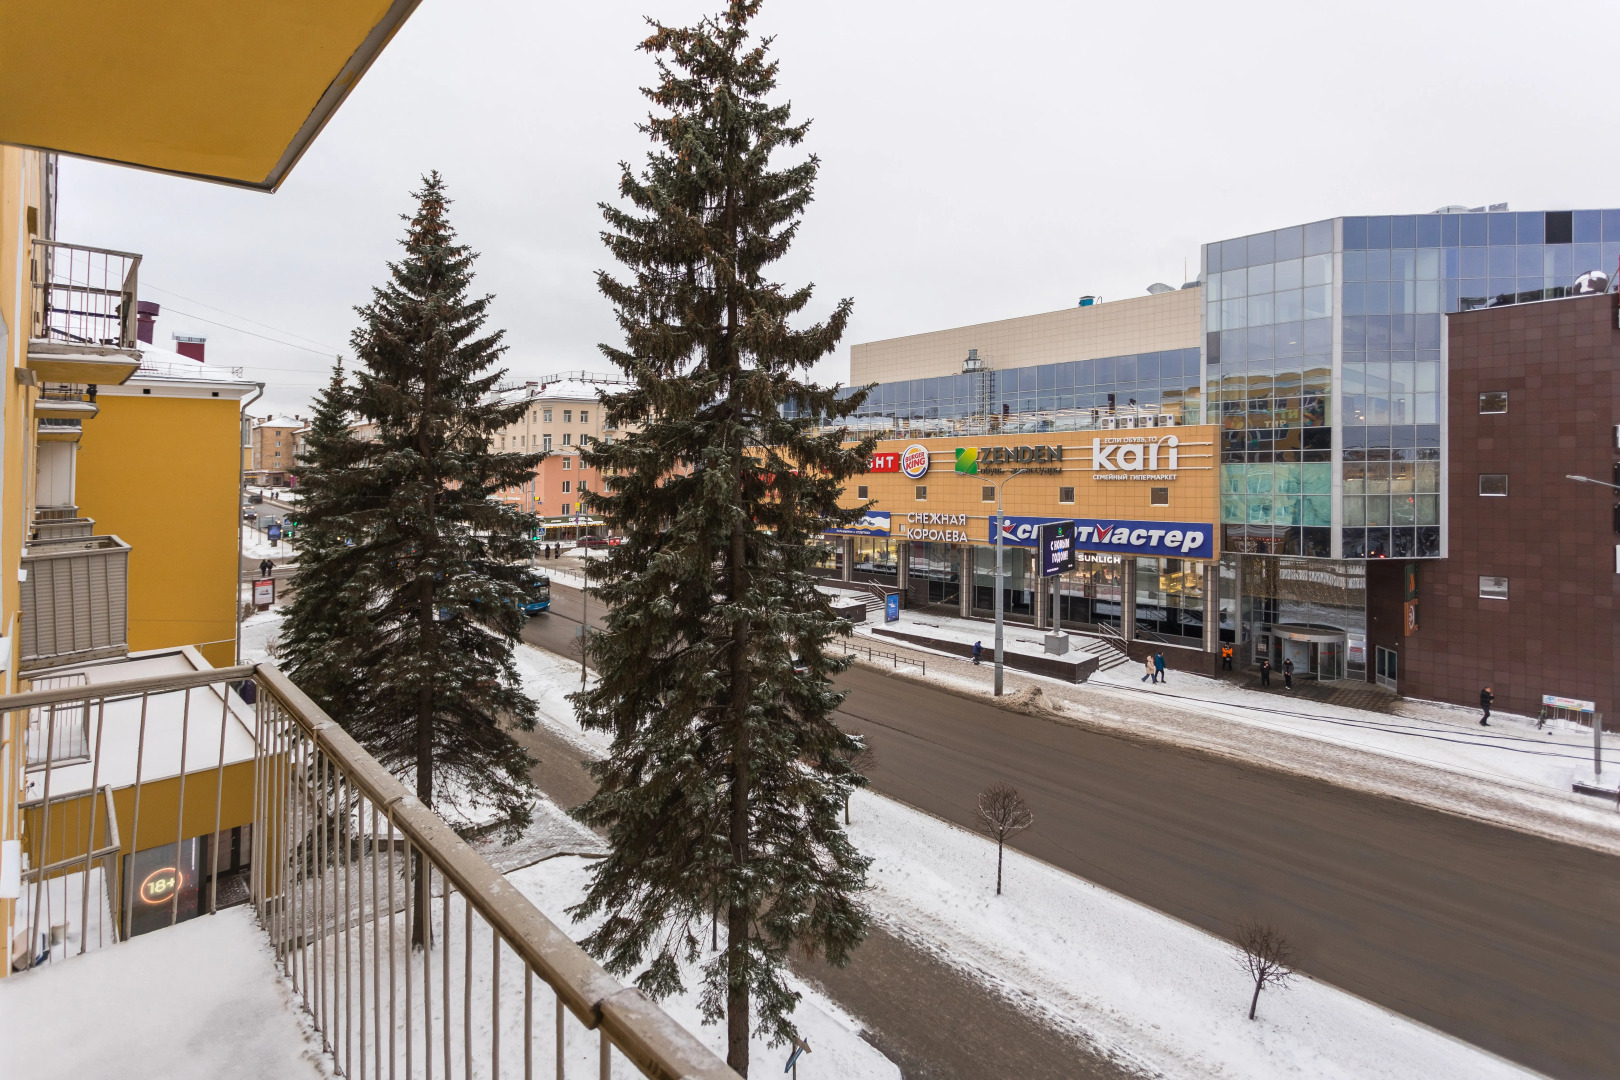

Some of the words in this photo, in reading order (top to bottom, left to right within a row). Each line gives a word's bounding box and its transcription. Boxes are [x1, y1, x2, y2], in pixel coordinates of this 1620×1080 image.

[905, 451, 925, 463] BURGER
[980, 444, 1063, 465] ZENDEN
[1092, 434, 1179, 471] kari
[905, 457, 926, 471] KING
[1092, 473, 1128, 481] СЕМЕЙНЫЙ
[1130, 473, 1177, 481] ГИПЕРМАРКЕТ
[907, 512, 966, 526] СНЕЖНАЯ
[907, 528, 968, 542] КОРОЛЕВА
[1078, 554, 1121, 564] SUNLIGH
[147, 877, 175, 895] 18+
